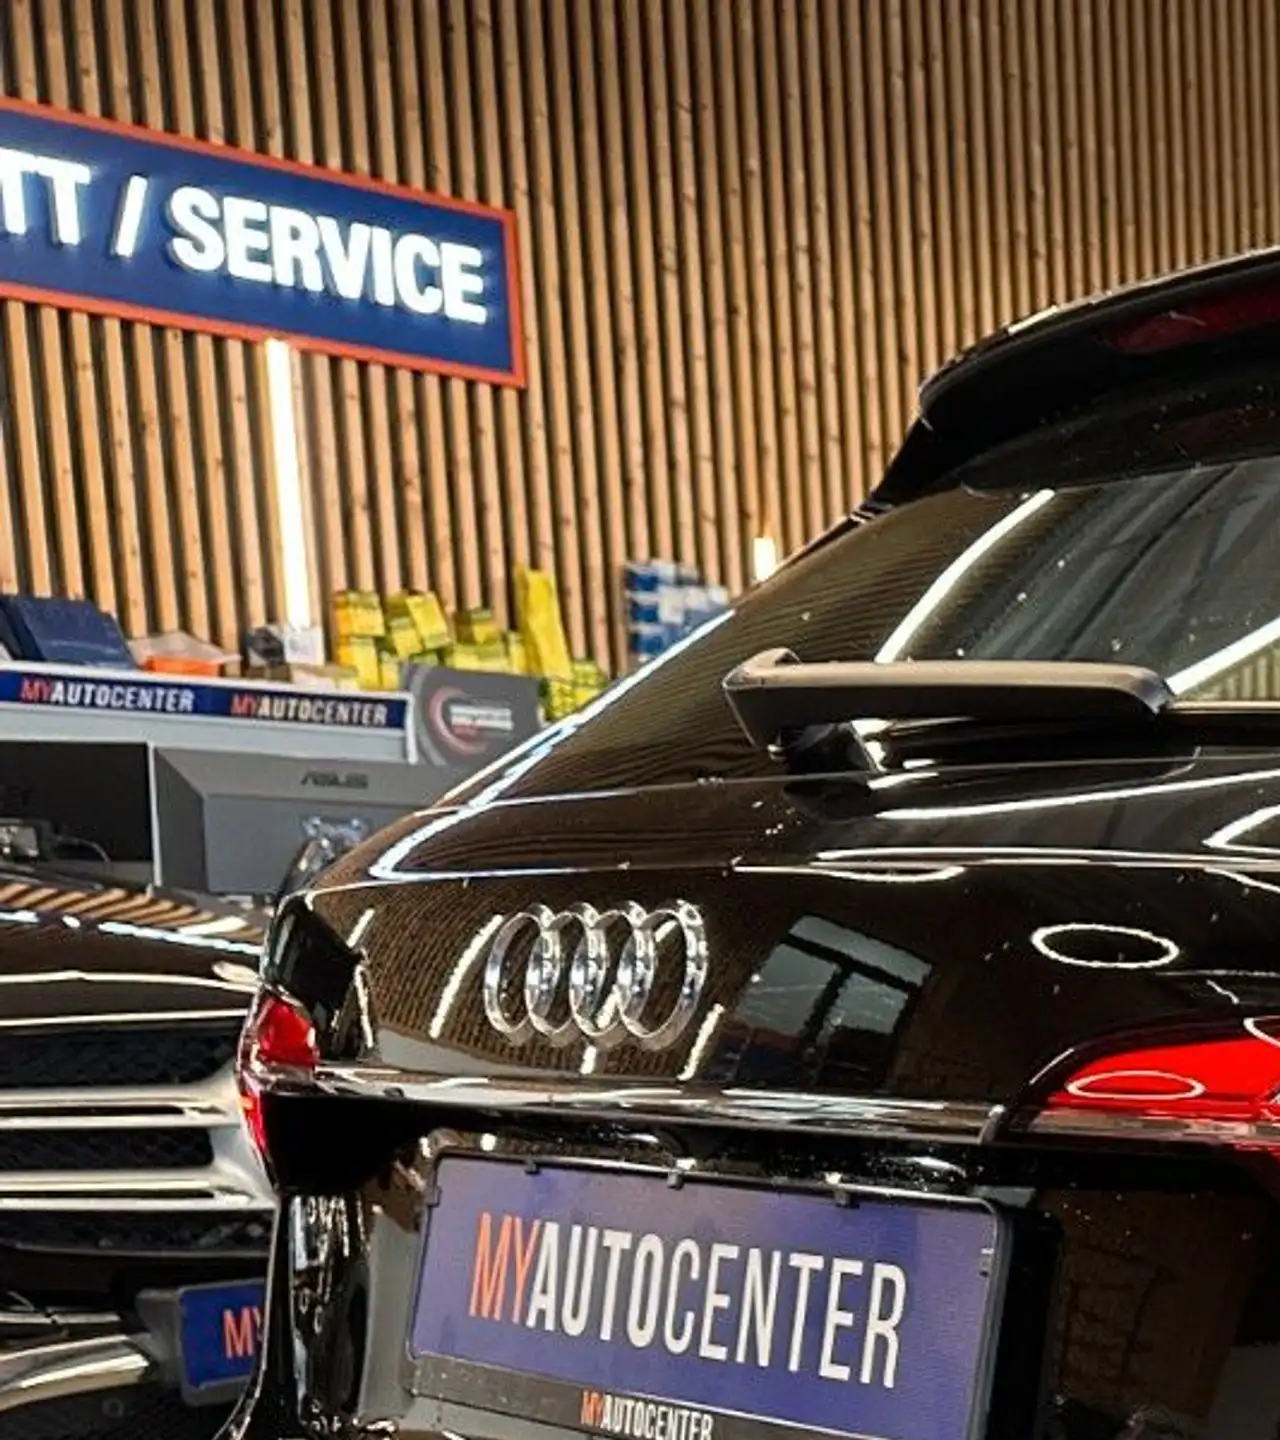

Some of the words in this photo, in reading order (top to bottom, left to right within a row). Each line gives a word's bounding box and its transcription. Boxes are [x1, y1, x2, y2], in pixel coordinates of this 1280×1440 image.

[169, 186, 488, 326] SERVICE
[20, 674, 195, 713] MYAUTOCENTER
[231, 693, 388, 726] MYAUTOCENTER
[468, 1211, 907, 1389] MYAUTOCENTER
